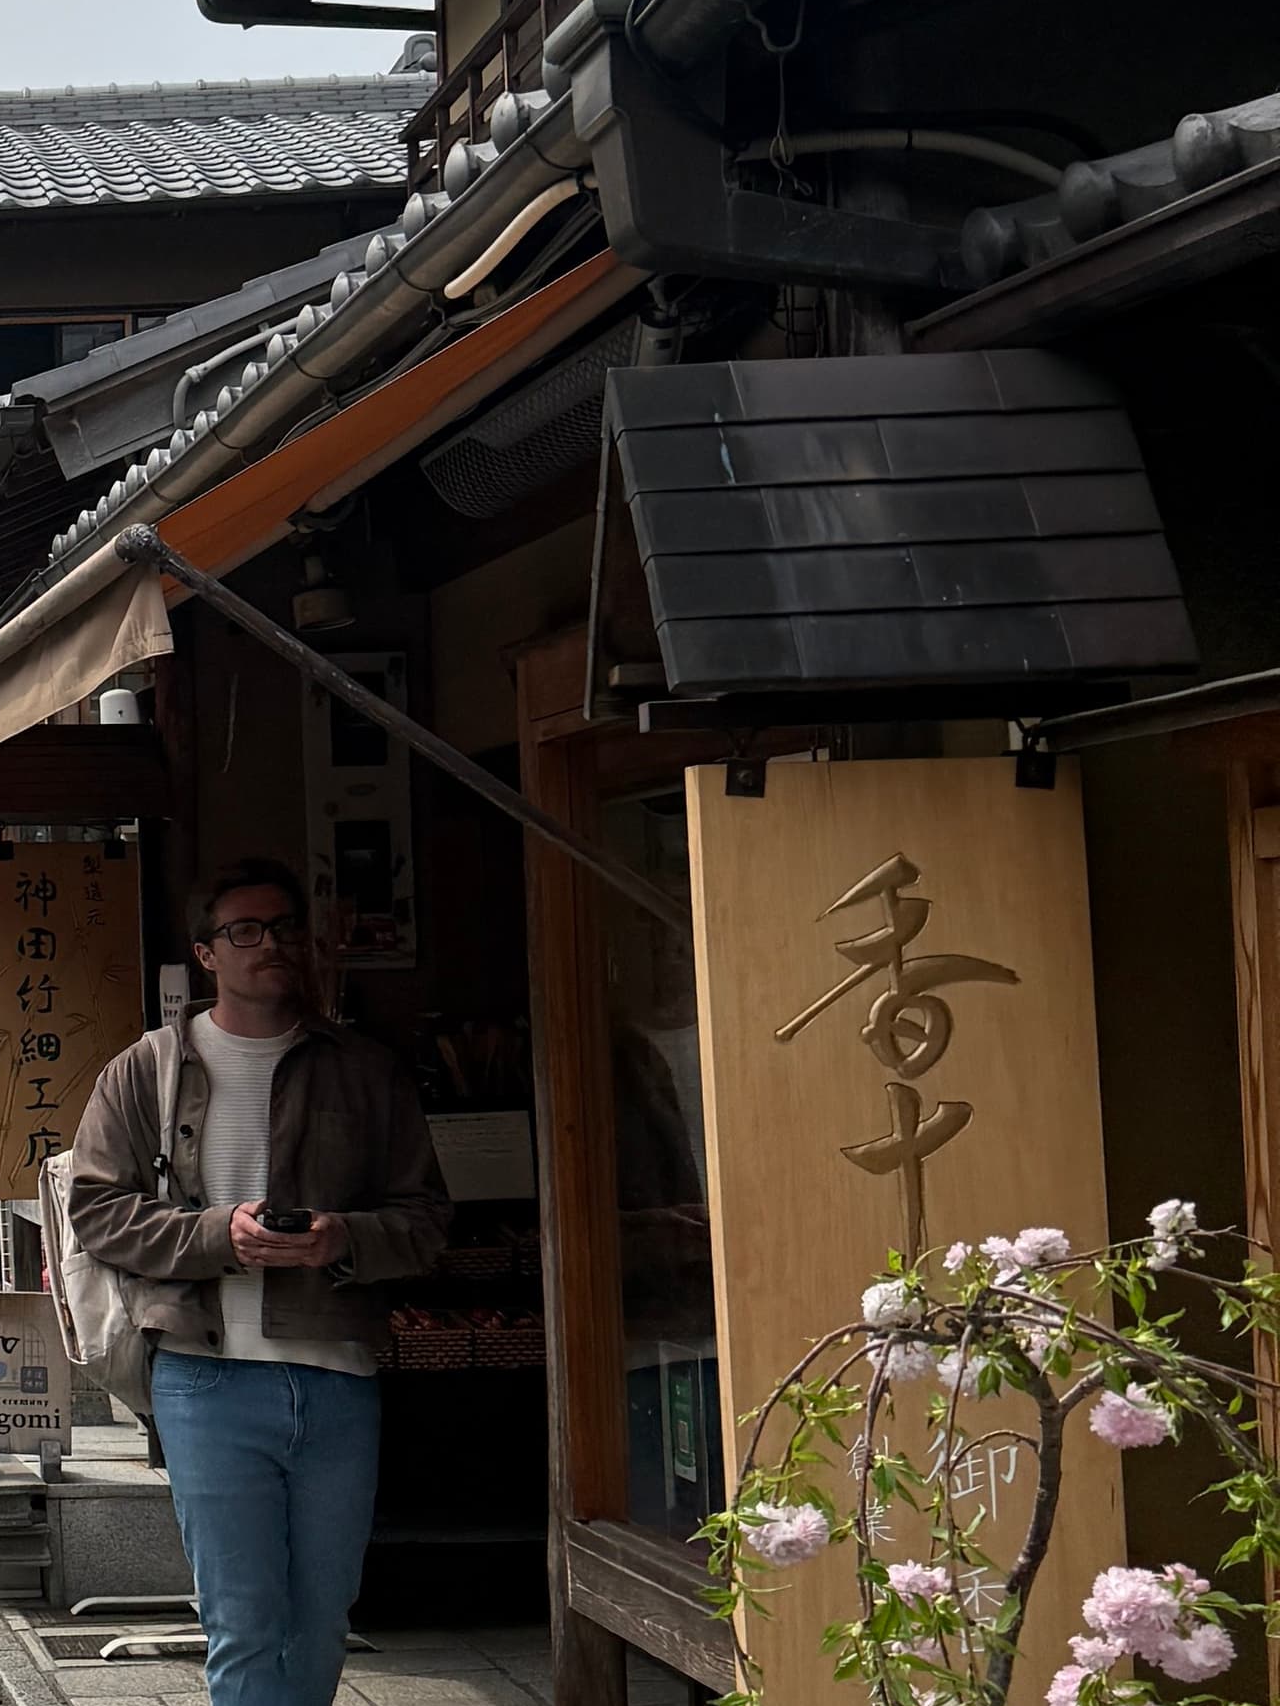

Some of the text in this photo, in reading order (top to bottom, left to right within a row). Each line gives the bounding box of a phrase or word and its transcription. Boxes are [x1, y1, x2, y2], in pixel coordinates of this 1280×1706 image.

[14, 870, 62, 1169] 神田竹細工店
